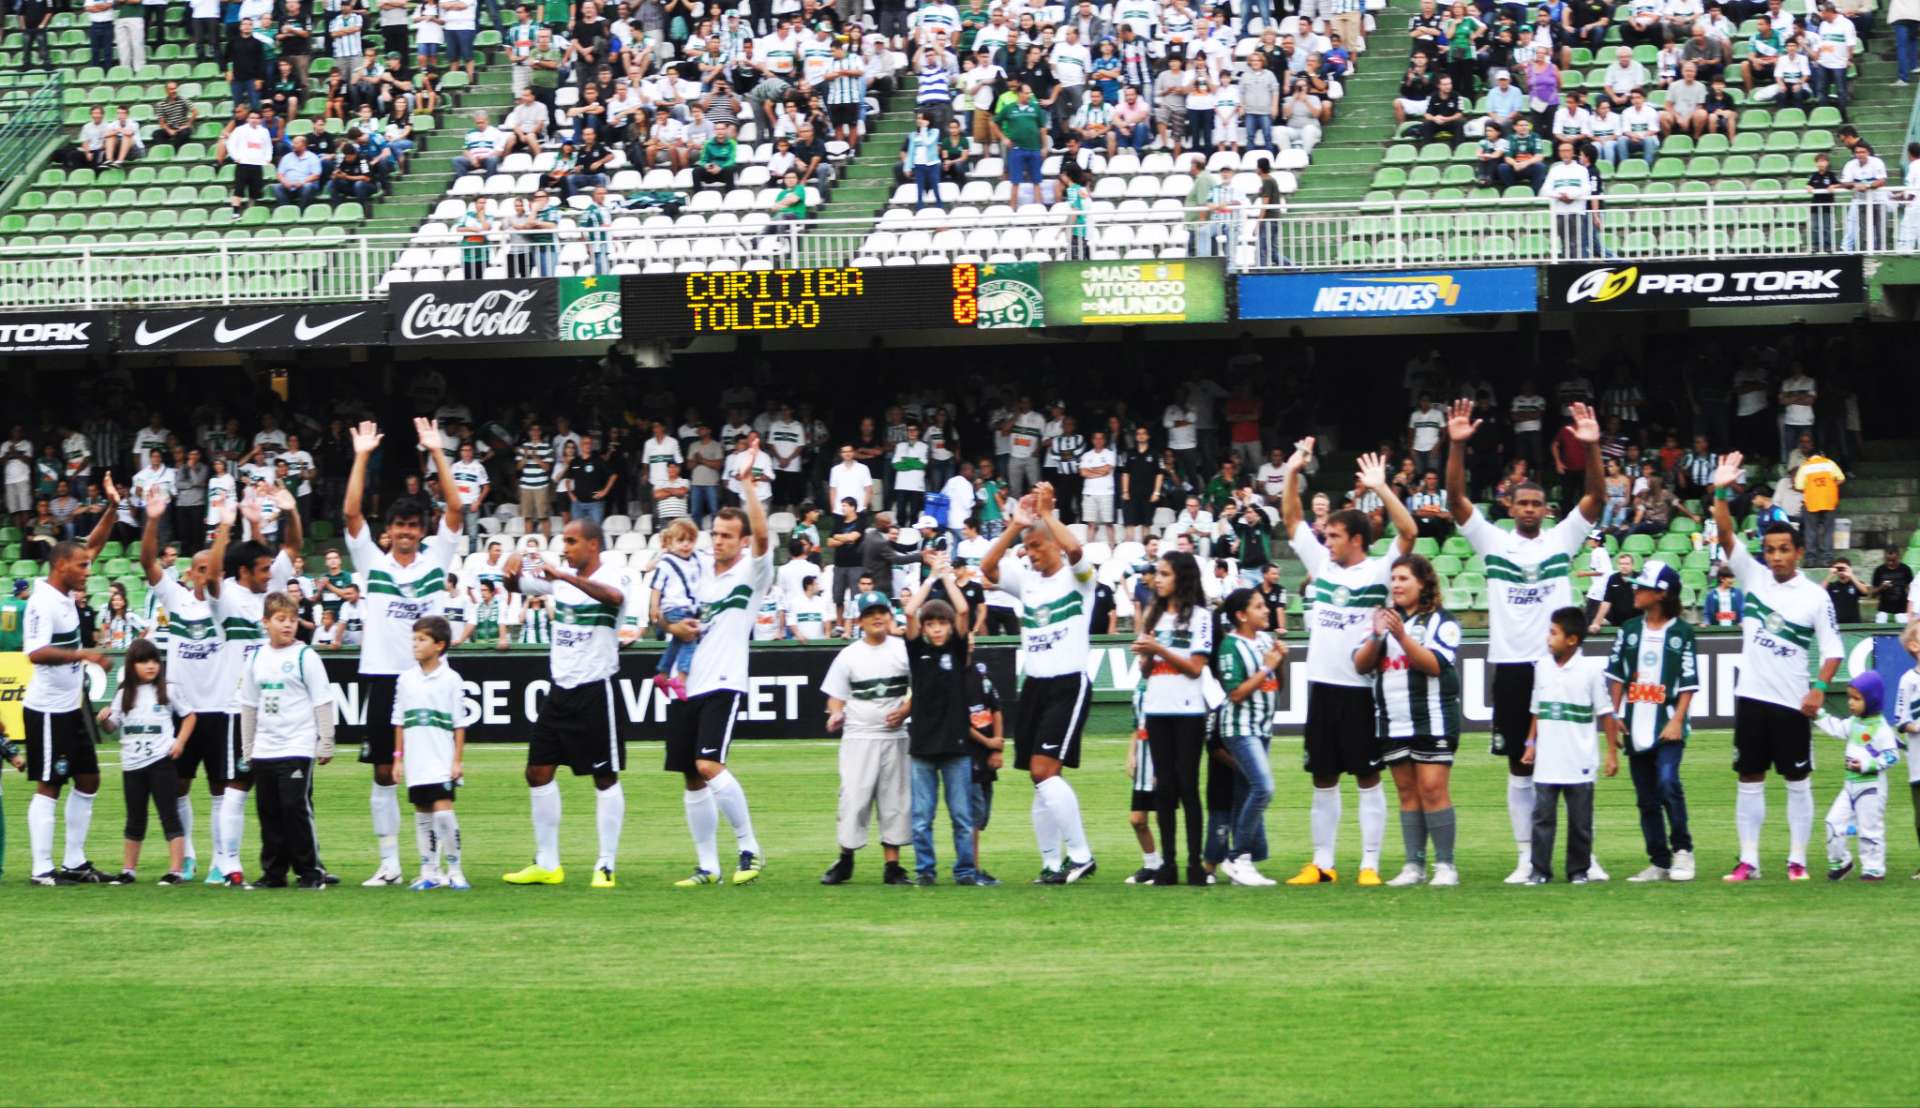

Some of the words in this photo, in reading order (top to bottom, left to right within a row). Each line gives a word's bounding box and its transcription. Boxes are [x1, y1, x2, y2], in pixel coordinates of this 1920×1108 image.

[686, 267, 863, 300] CORITIBA
[952, 263, 976, 292] 0
[1090, 265, 1140, 281] MAIS
[1637, 273, 1725, 294] PRO
[1730, 269, 1842, 292] TORK
[1081, 280, 1185, 297] VITORIOSO
[1312, 283, 1438, 312] NETSHOES
[401, 288, 538, 340] Coca-Cola
[687, 300, 820, 331] TOLEDO
[953, 294, 977, 324] 0
[977, 304, 1025, 330] CFC
[1097, 295, 1186, 315] MUNDO
[0, 321, 92, 342] TORK
[577, 315, 622, 341] CFC
